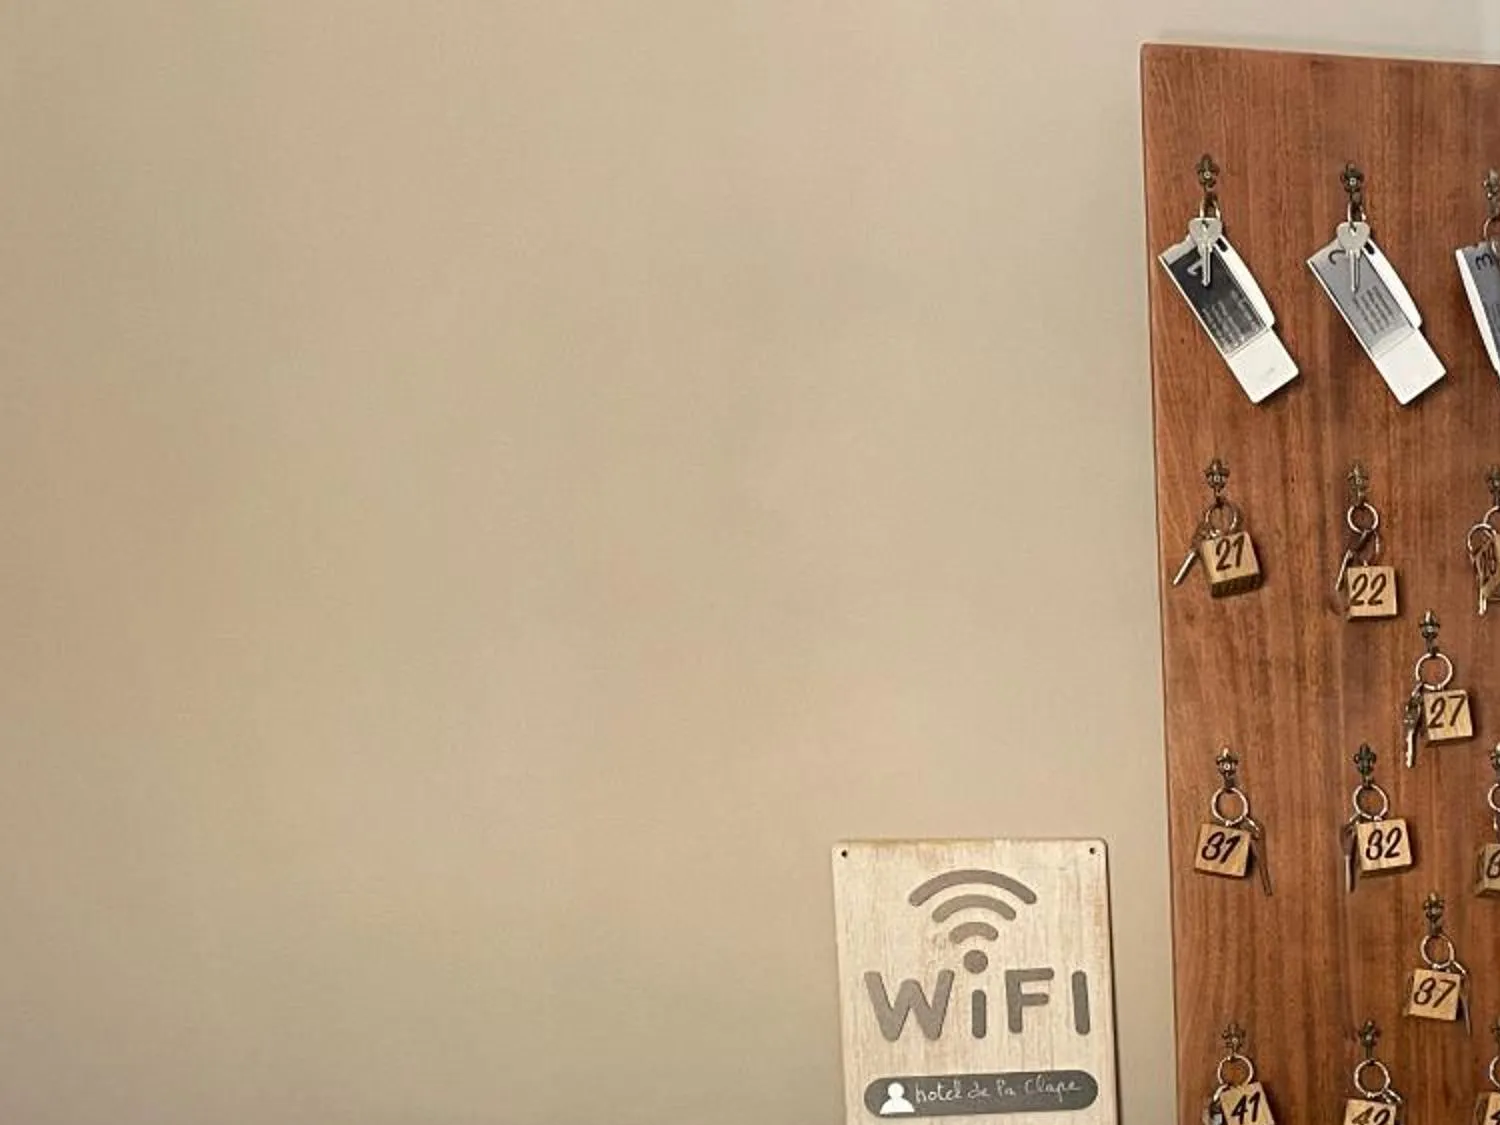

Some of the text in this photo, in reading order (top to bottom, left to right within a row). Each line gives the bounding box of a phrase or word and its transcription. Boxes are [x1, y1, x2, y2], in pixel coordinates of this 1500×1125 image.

[1214, 535, 1246, 572] 21
[1350, 572, 1388, 607] 22
[1427, 693, 1466, 730] 27
[967, 1080, 992, 1099] de
